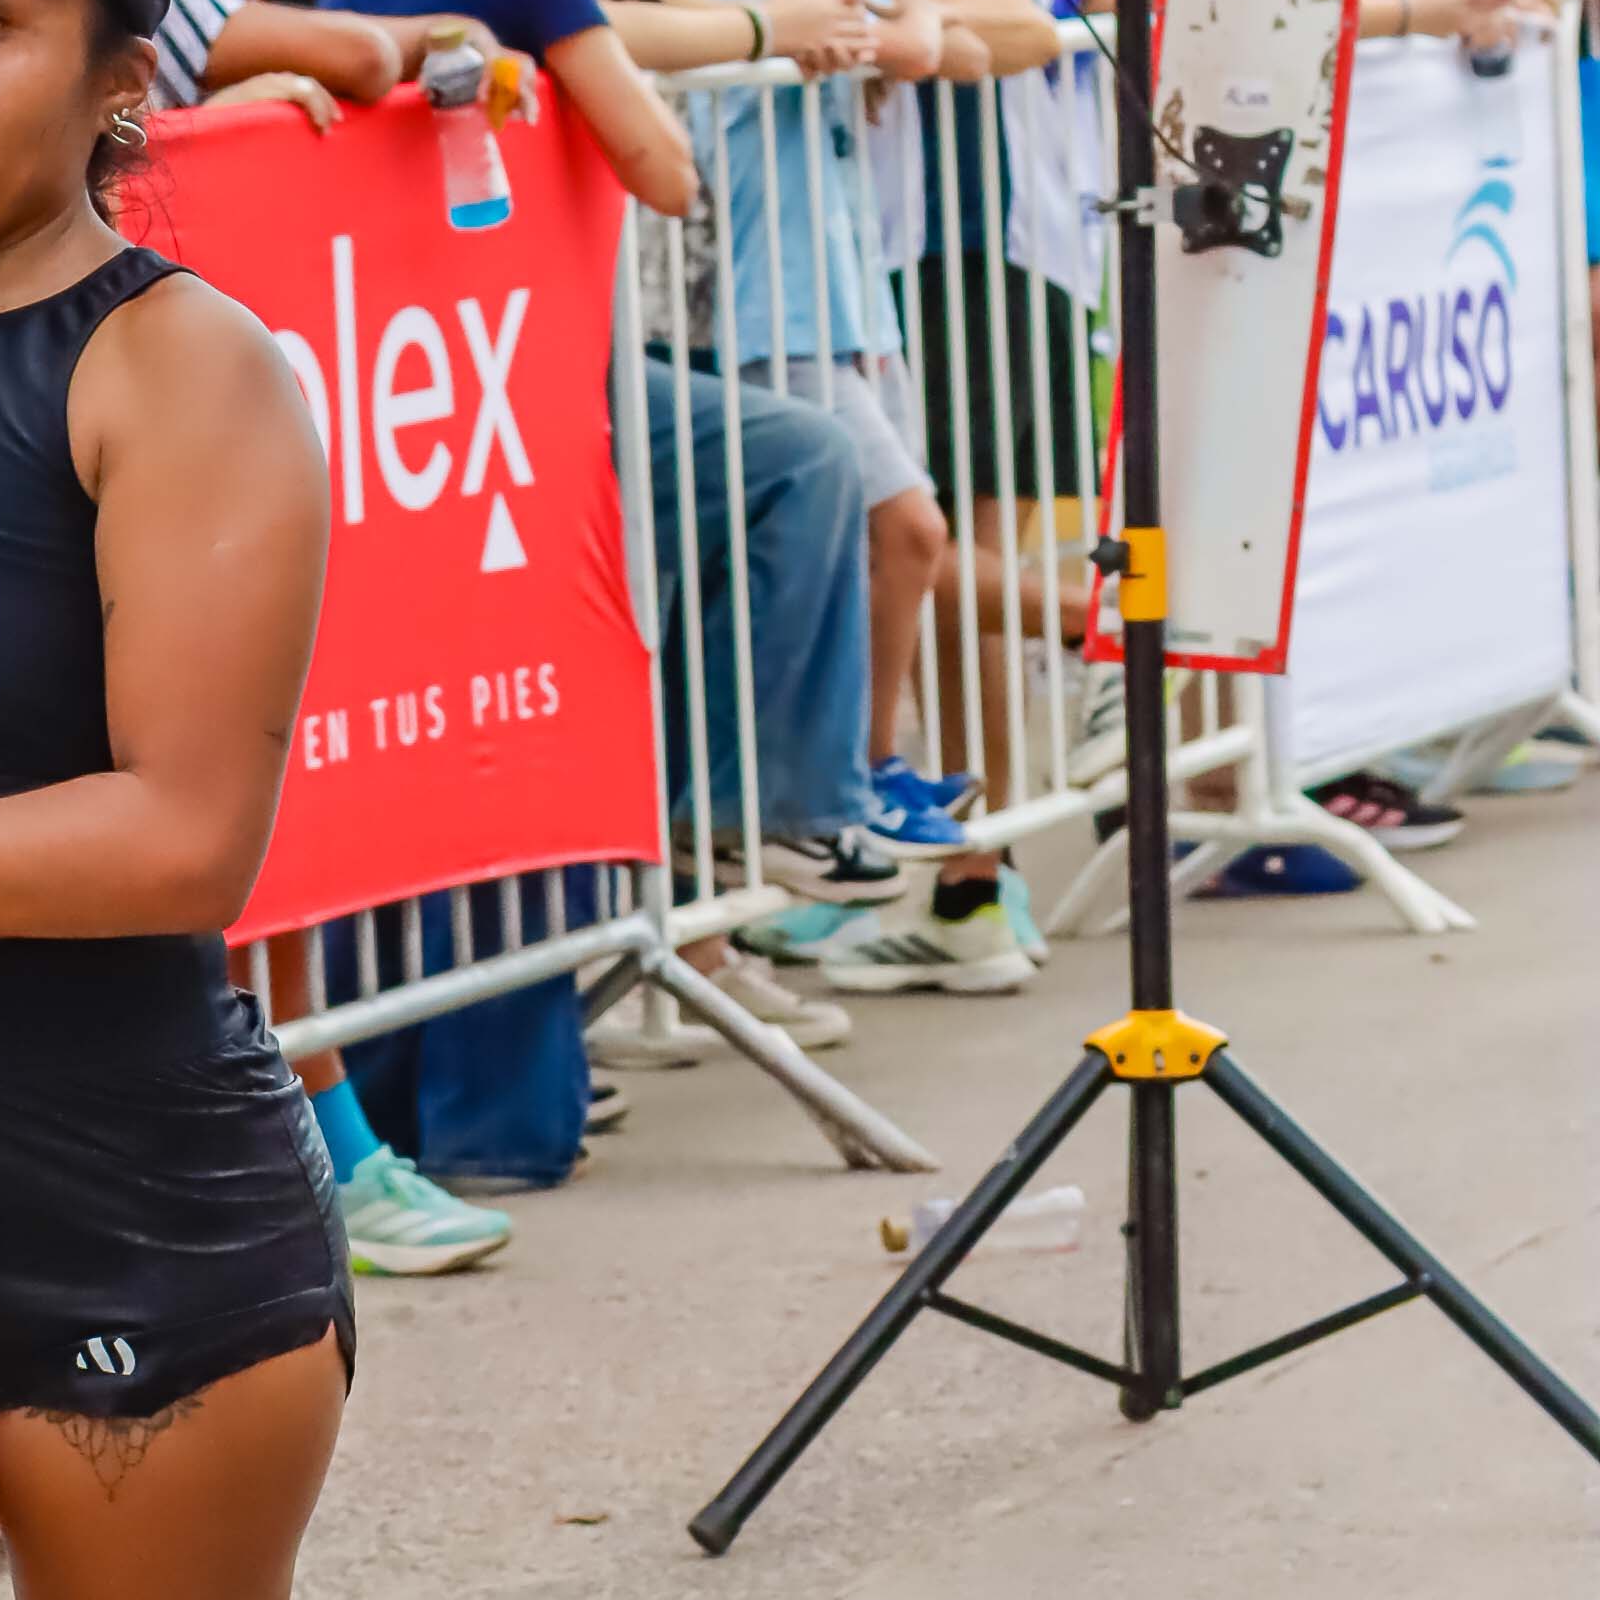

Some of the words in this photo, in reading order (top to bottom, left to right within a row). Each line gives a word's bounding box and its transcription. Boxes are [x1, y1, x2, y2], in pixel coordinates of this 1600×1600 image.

[1319, 282, 1511, 451] CARUSO
[304, 709, 348, 770] EN
[369, 685, 446, 749] TUS
[470, 663, 560, 726] PIES
